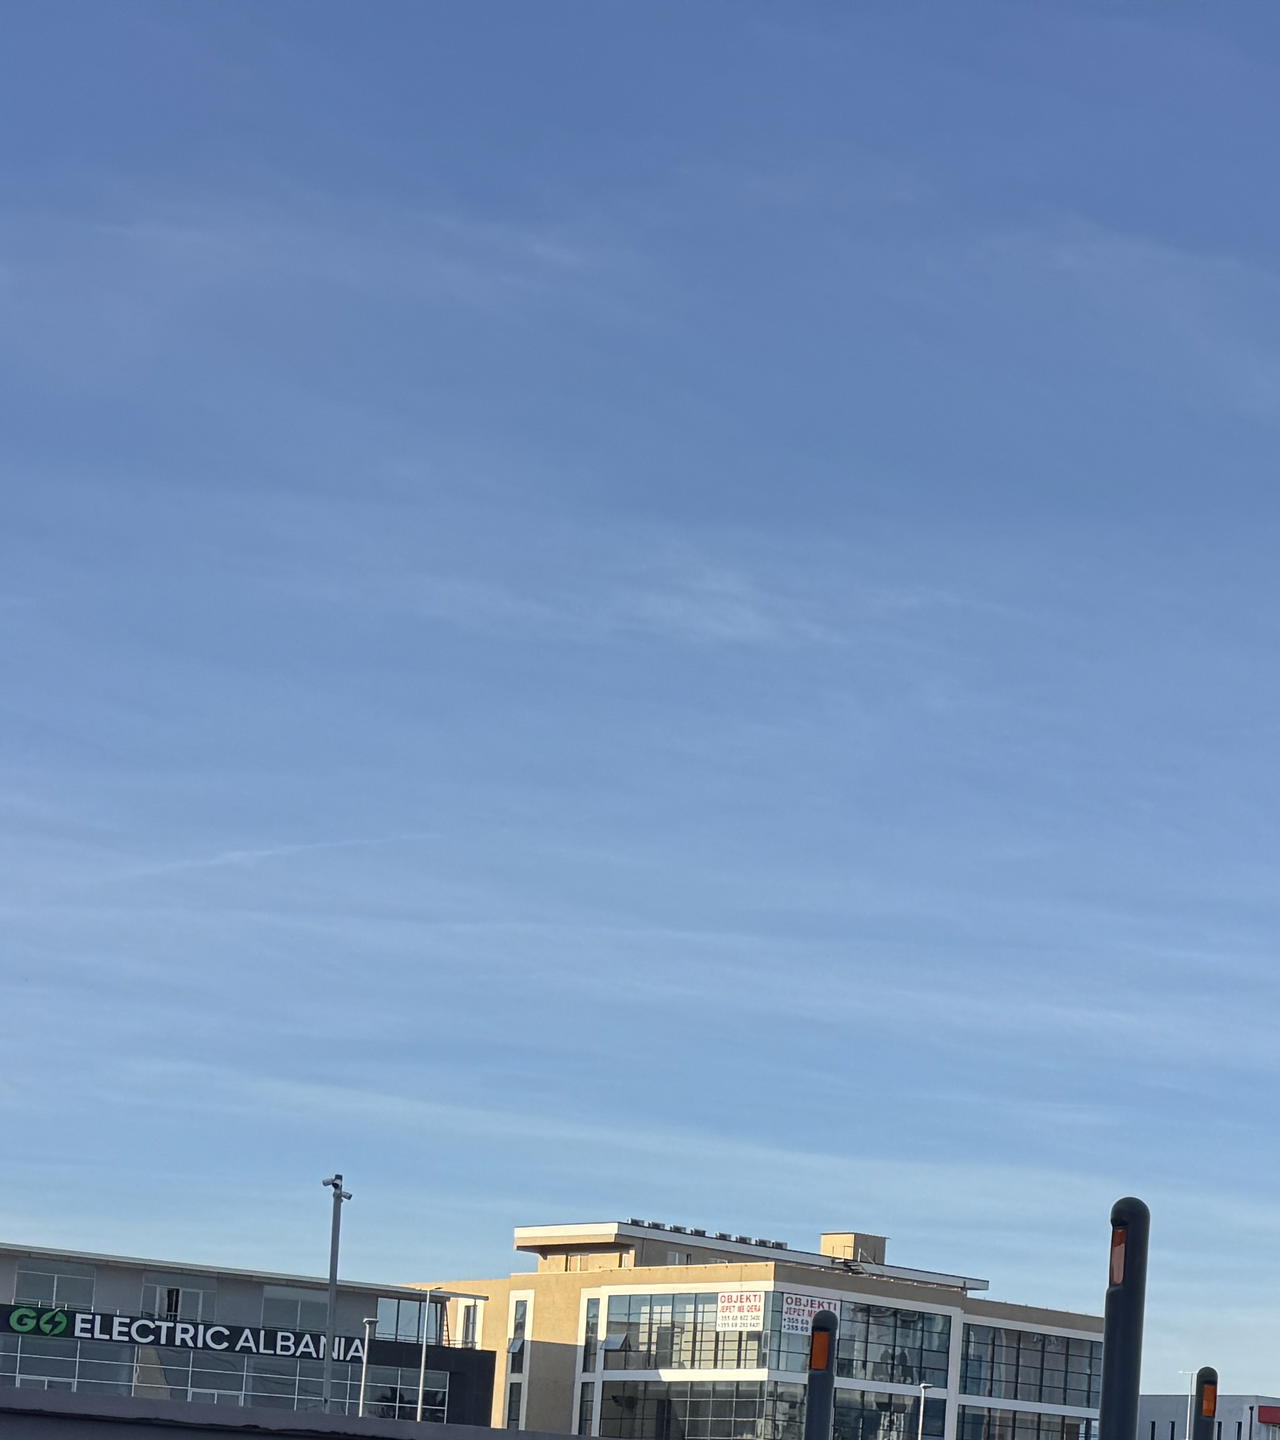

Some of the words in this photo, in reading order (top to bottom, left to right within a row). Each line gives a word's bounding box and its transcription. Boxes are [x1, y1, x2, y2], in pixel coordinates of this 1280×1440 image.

[720, 1294, 762, 1304] OBJEKTI
[785, 1296, 837, 1311] OBJEKTI
[74, 1313, 230, 1350] ELECTRIC
[235, 1328, 366, 1361] ALBANIA
